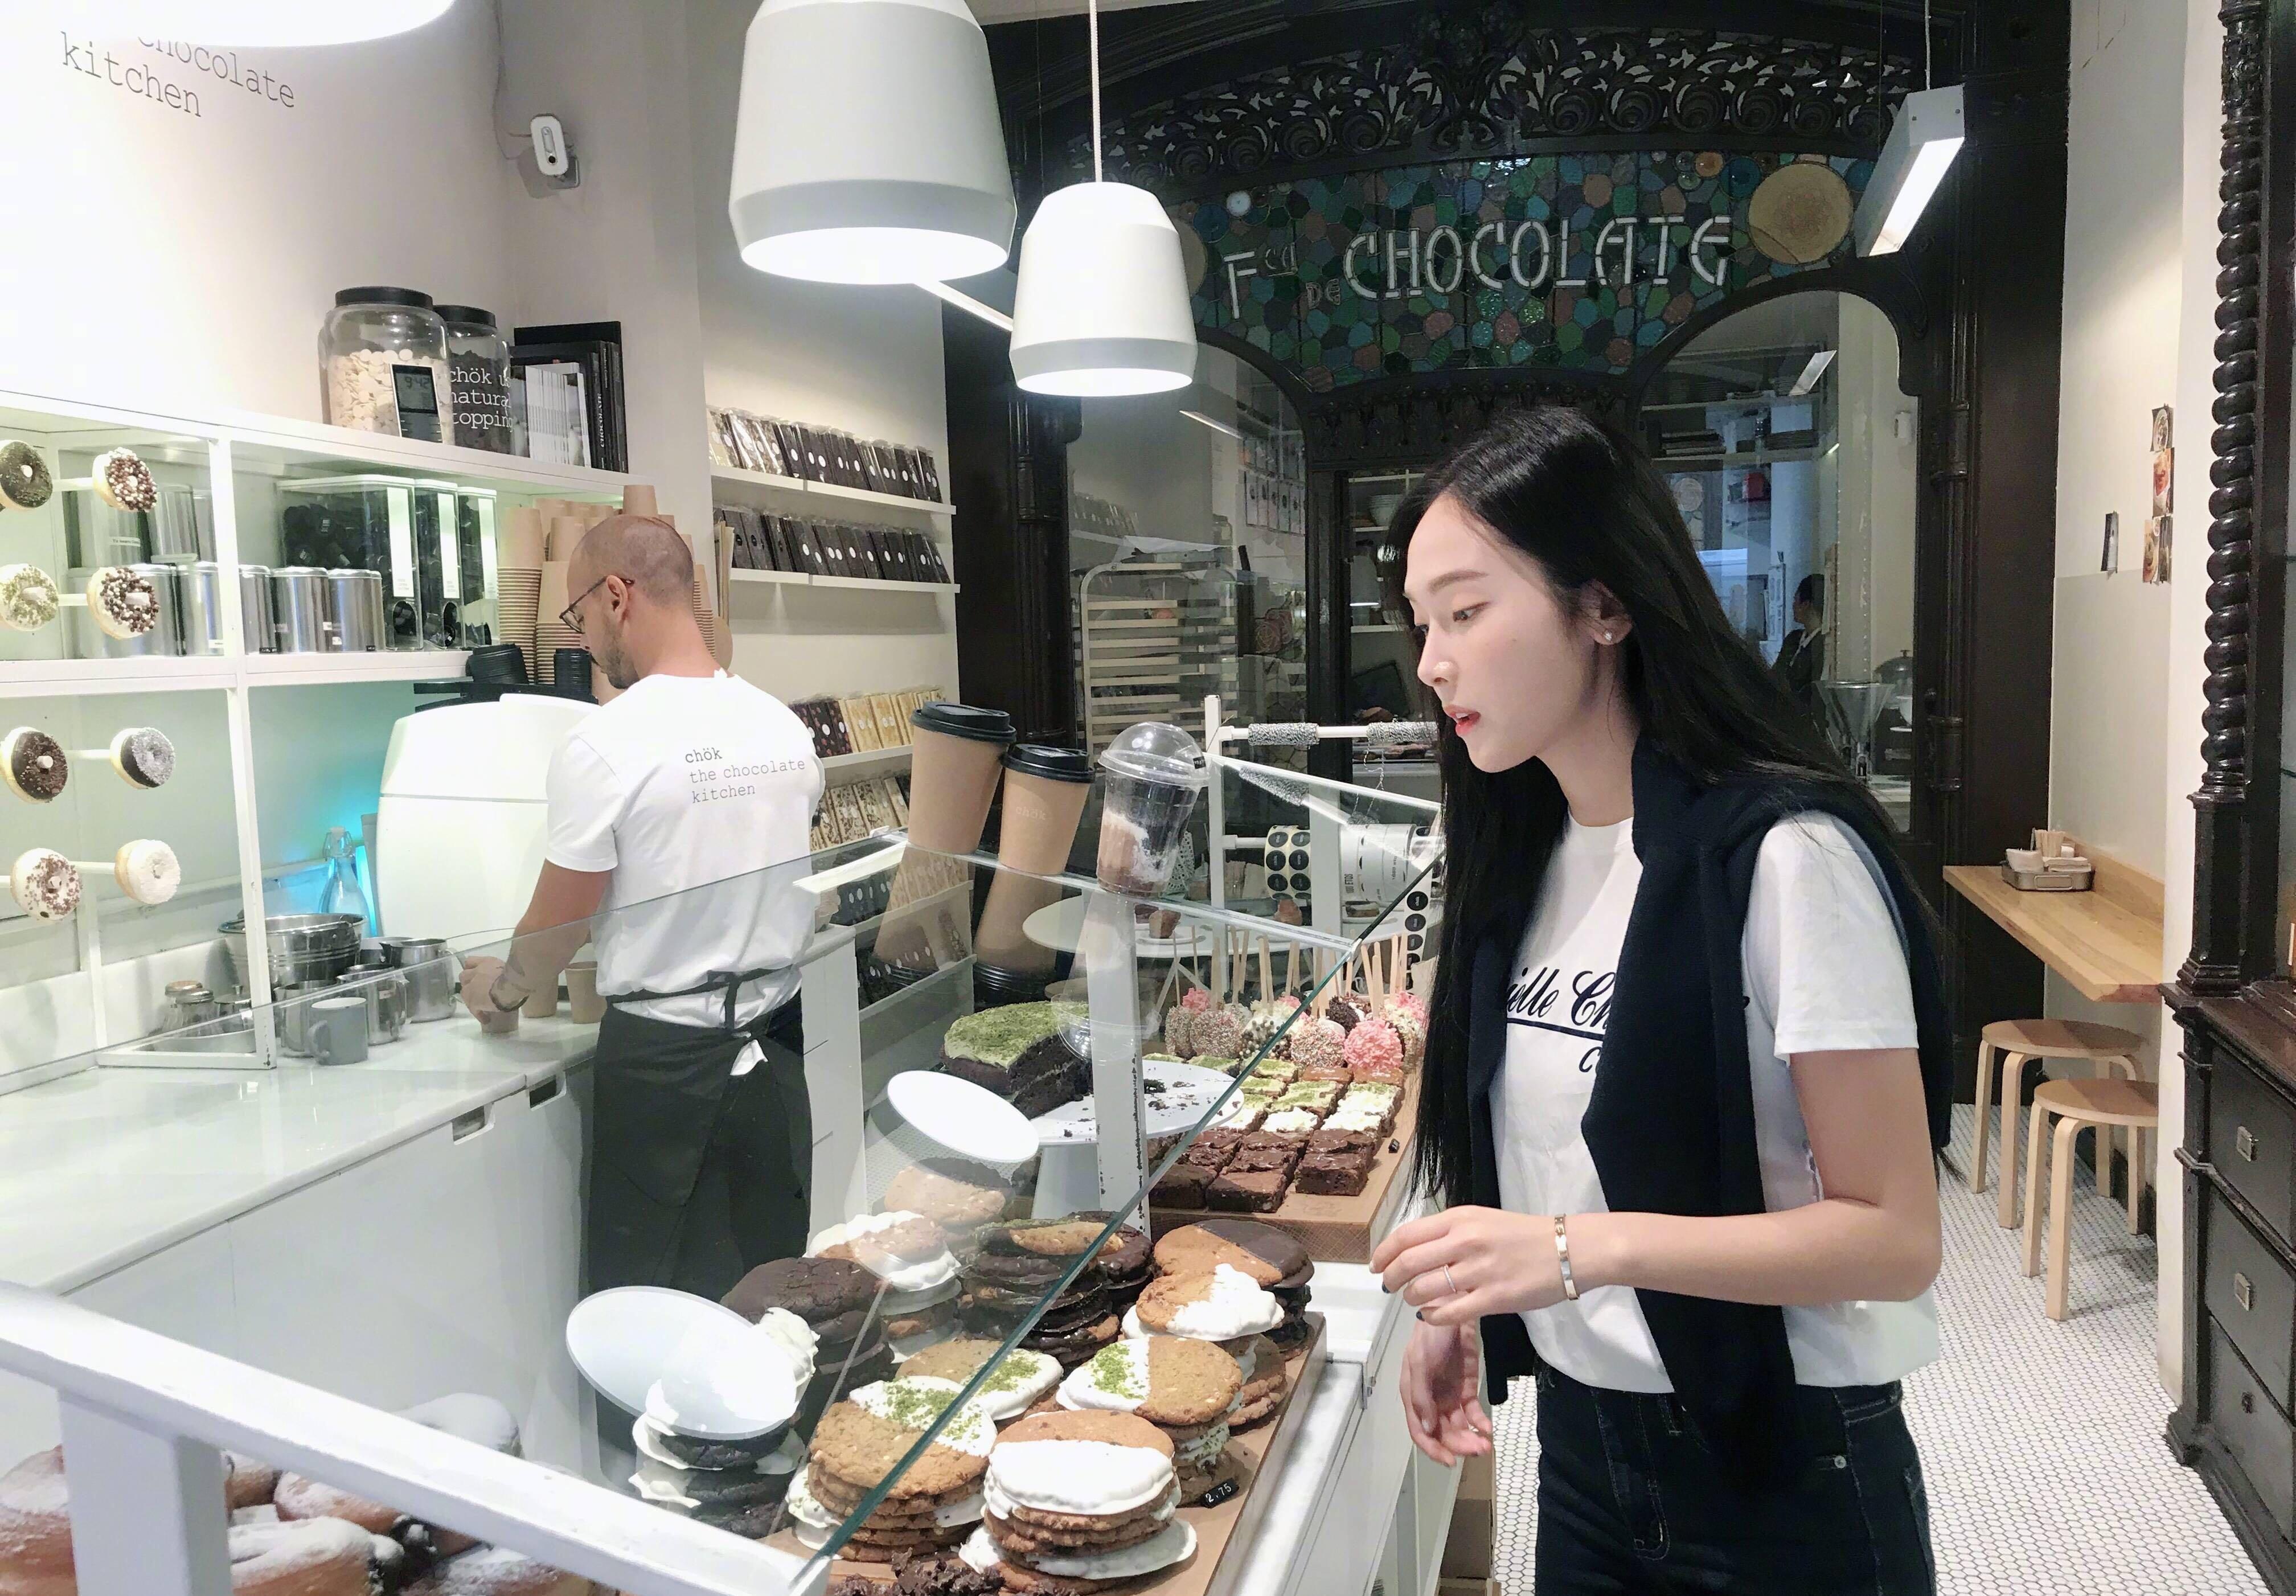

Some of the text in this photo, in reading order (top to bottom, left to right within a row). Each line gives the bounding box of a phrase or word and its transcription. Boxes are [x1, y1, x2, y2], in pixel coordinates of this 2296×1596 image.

[60, 31, 201, 117] kitchen
[1344, 216, 1731, 299] CHOCOLATE
[450, 366, 492, 385] chök
[685, 747, 723, 763] chök
[690, 760, 805, 783] the chocolate
[692, 785, 756, 803] kitchen
[1507, 967, 1560, 1018] ille
